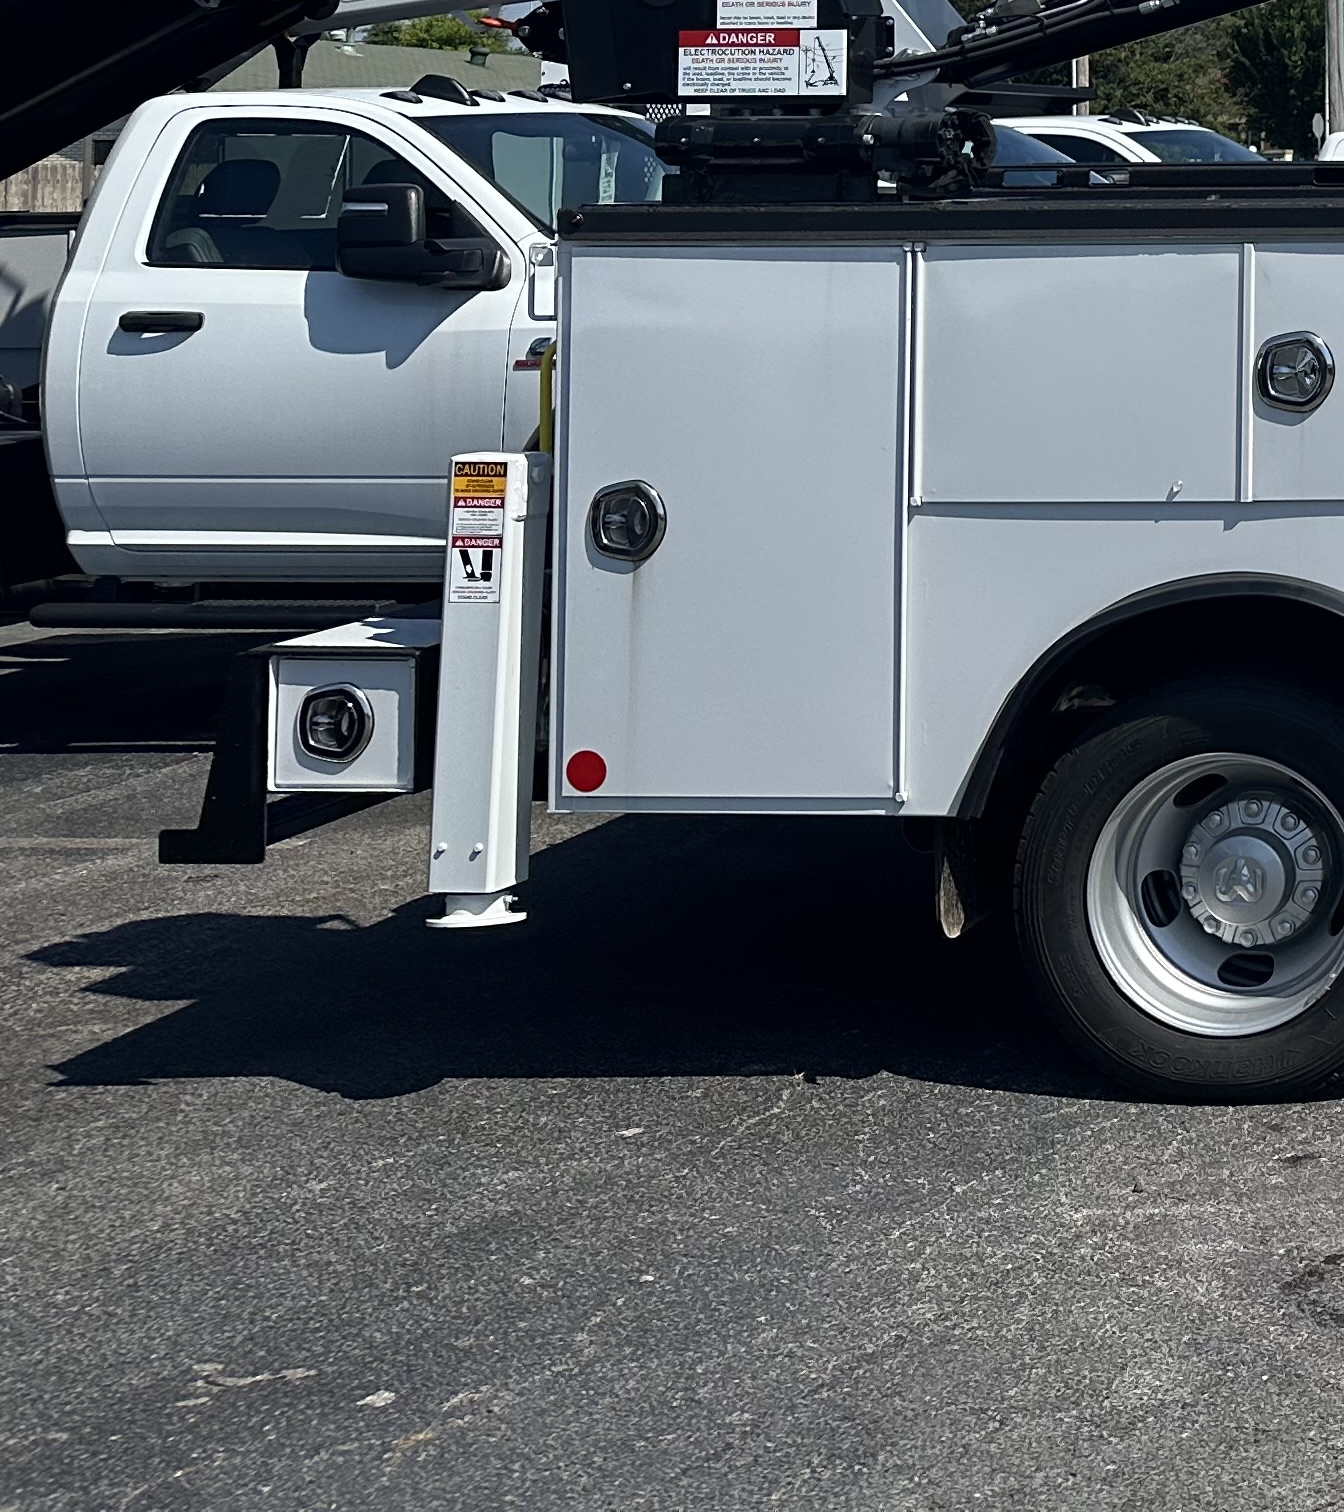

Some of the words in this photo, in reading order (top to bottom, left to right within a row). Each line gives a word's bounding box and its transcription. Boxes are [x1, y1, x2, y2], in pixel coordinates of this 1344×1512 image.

[719, 33, 775, 44] DANGER
[683, 48, 756, 56] ELECTROCUTION
[758, 48, 795, 56] HAZARD
[455, 464, 505, 476] CAUTION
[466, 498, 502, 507] DANGER
[464, 538, 500, 547] DANGER
